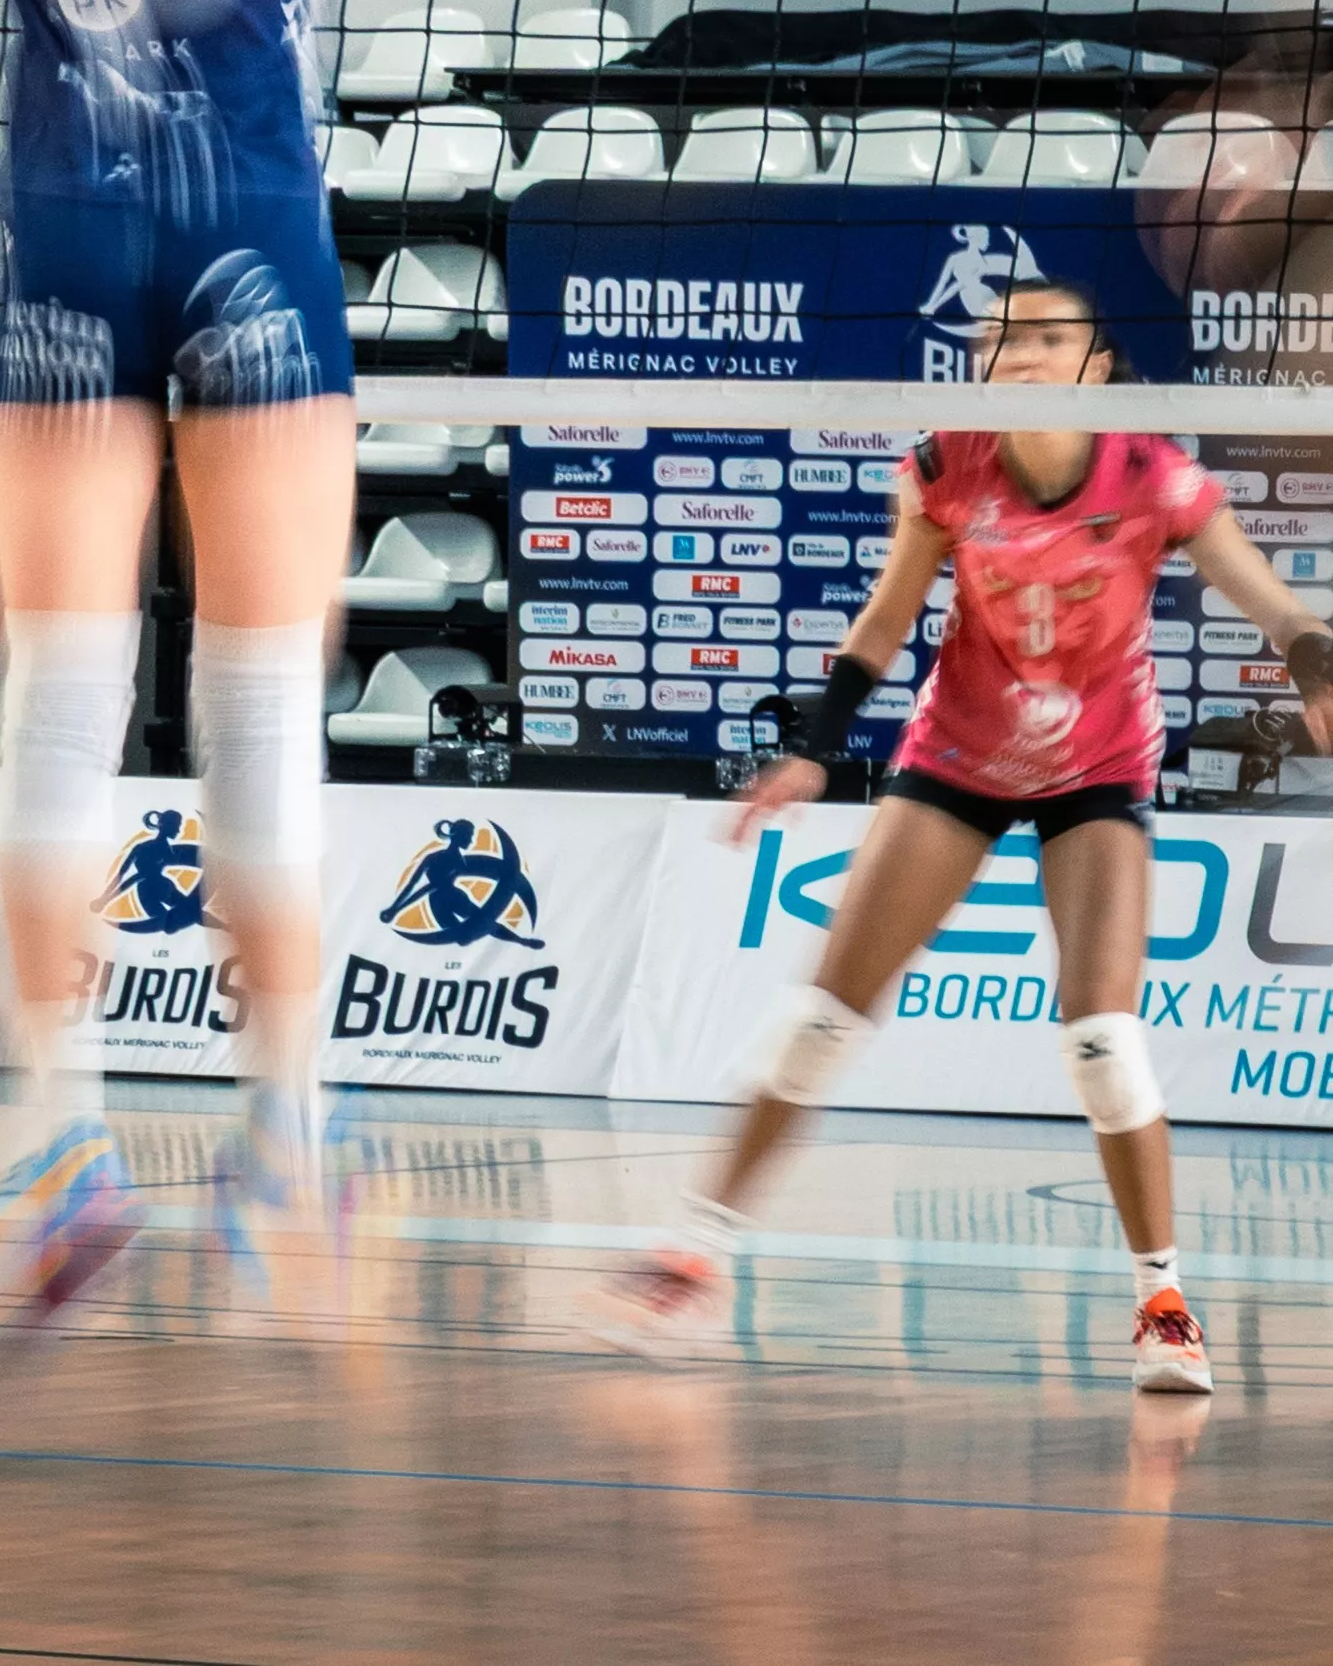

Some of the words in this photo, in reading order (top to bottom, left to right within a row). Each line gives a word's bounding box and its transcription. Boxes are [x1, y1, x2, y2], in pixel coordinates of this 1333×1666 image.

[565, 276, 804, 342] BORDEAUX
[569, 348, 696, 374] MÉRIGNAC
[707, 356, 798, 376] VOLLEY
[818, 430, 892, 450] Saforelle
[559, 500, 608, 517] Betclic
[682, 501, 754, 522] Saforelle
[1242, 516, 1308, 536] aforelle
[731, 543, 761, 556] LNV
[701, 577, 732, 591] RMC
[699, 650, 731, 665] RMC
[1250, 667, 1281, 682] RMC
[152, 949, 169, 958] LES
[445, 962, 462, 970] LES
[330, 954, 559, 1049] BURDIS
[467, 1054, 501, 1064] VOLLEY
